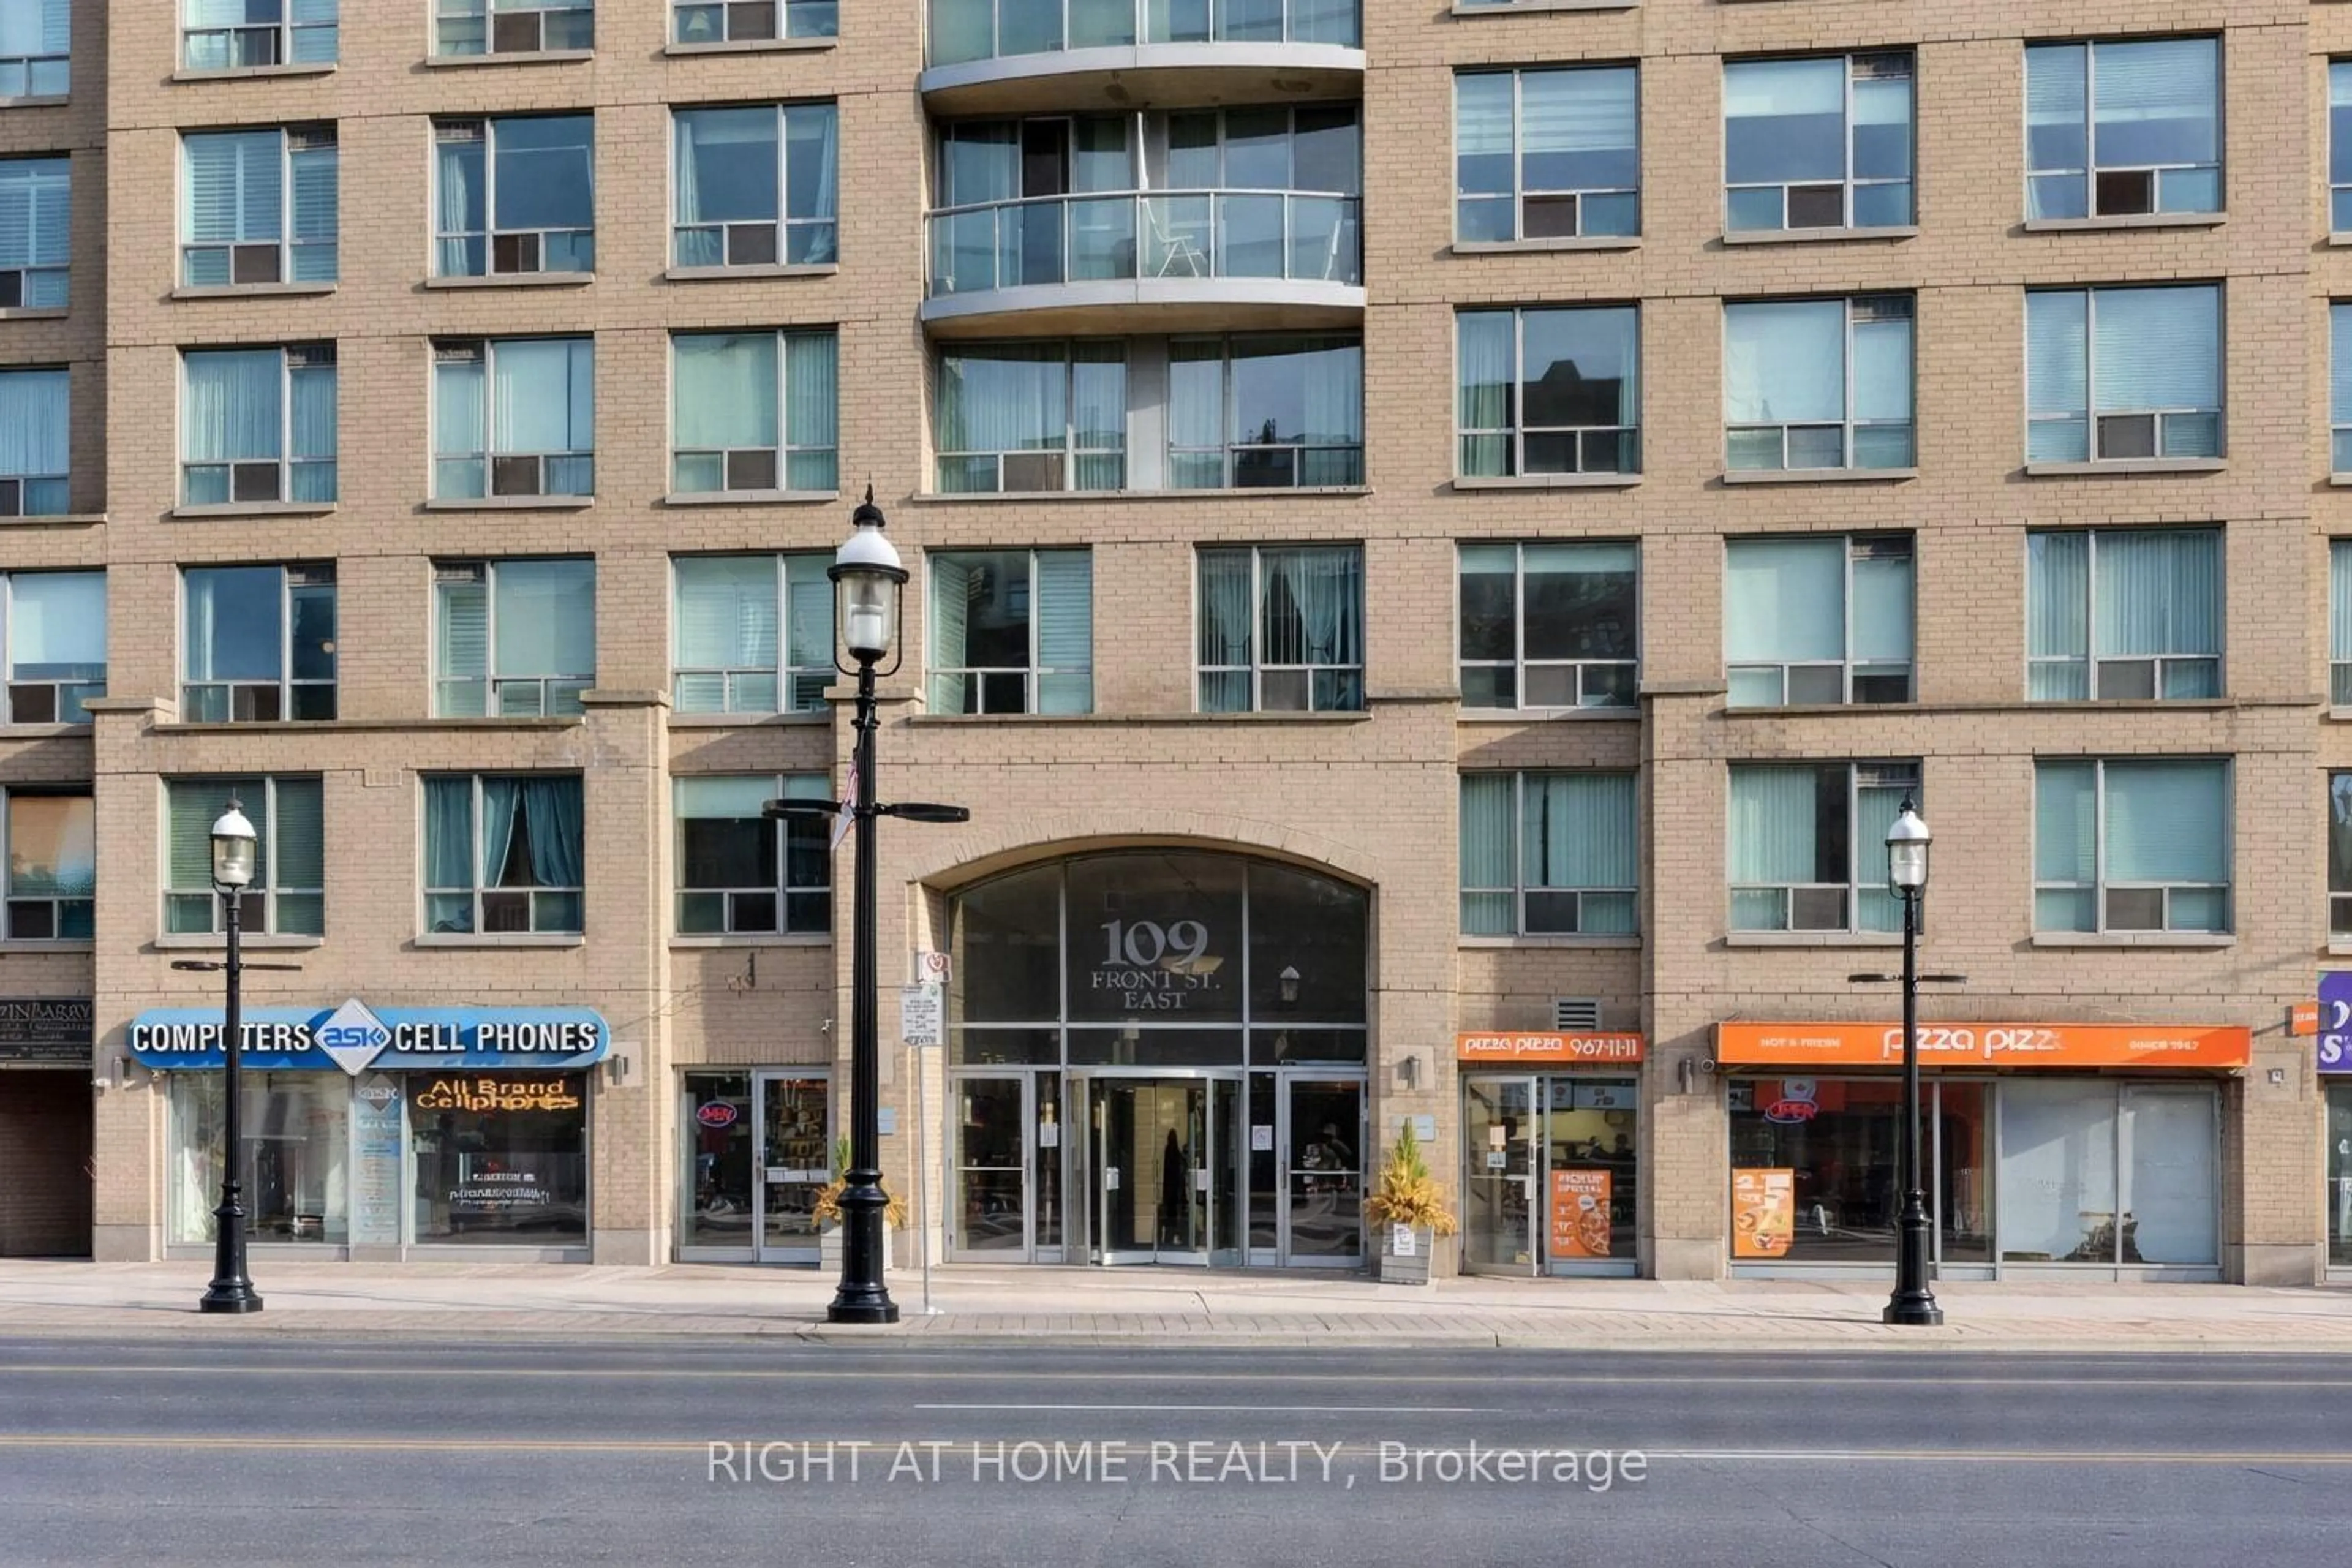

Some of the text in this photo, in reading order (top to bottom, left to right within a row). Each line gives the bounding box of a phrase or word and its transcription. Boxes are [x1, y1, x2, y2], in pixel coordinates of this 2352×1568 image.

[1100, 919, 1208, 966] 109
[1091, 970, 1170, 989] FRONT
[1124, 991, 1188, 1009] EAST
[395, 1023, 466, 1051] CELL
[477, 1023, 598, 1051] PHONES
[1883, 1028, 2067, 1059] pzza pizz
[431, 1079, 565, 1095] All Brand
